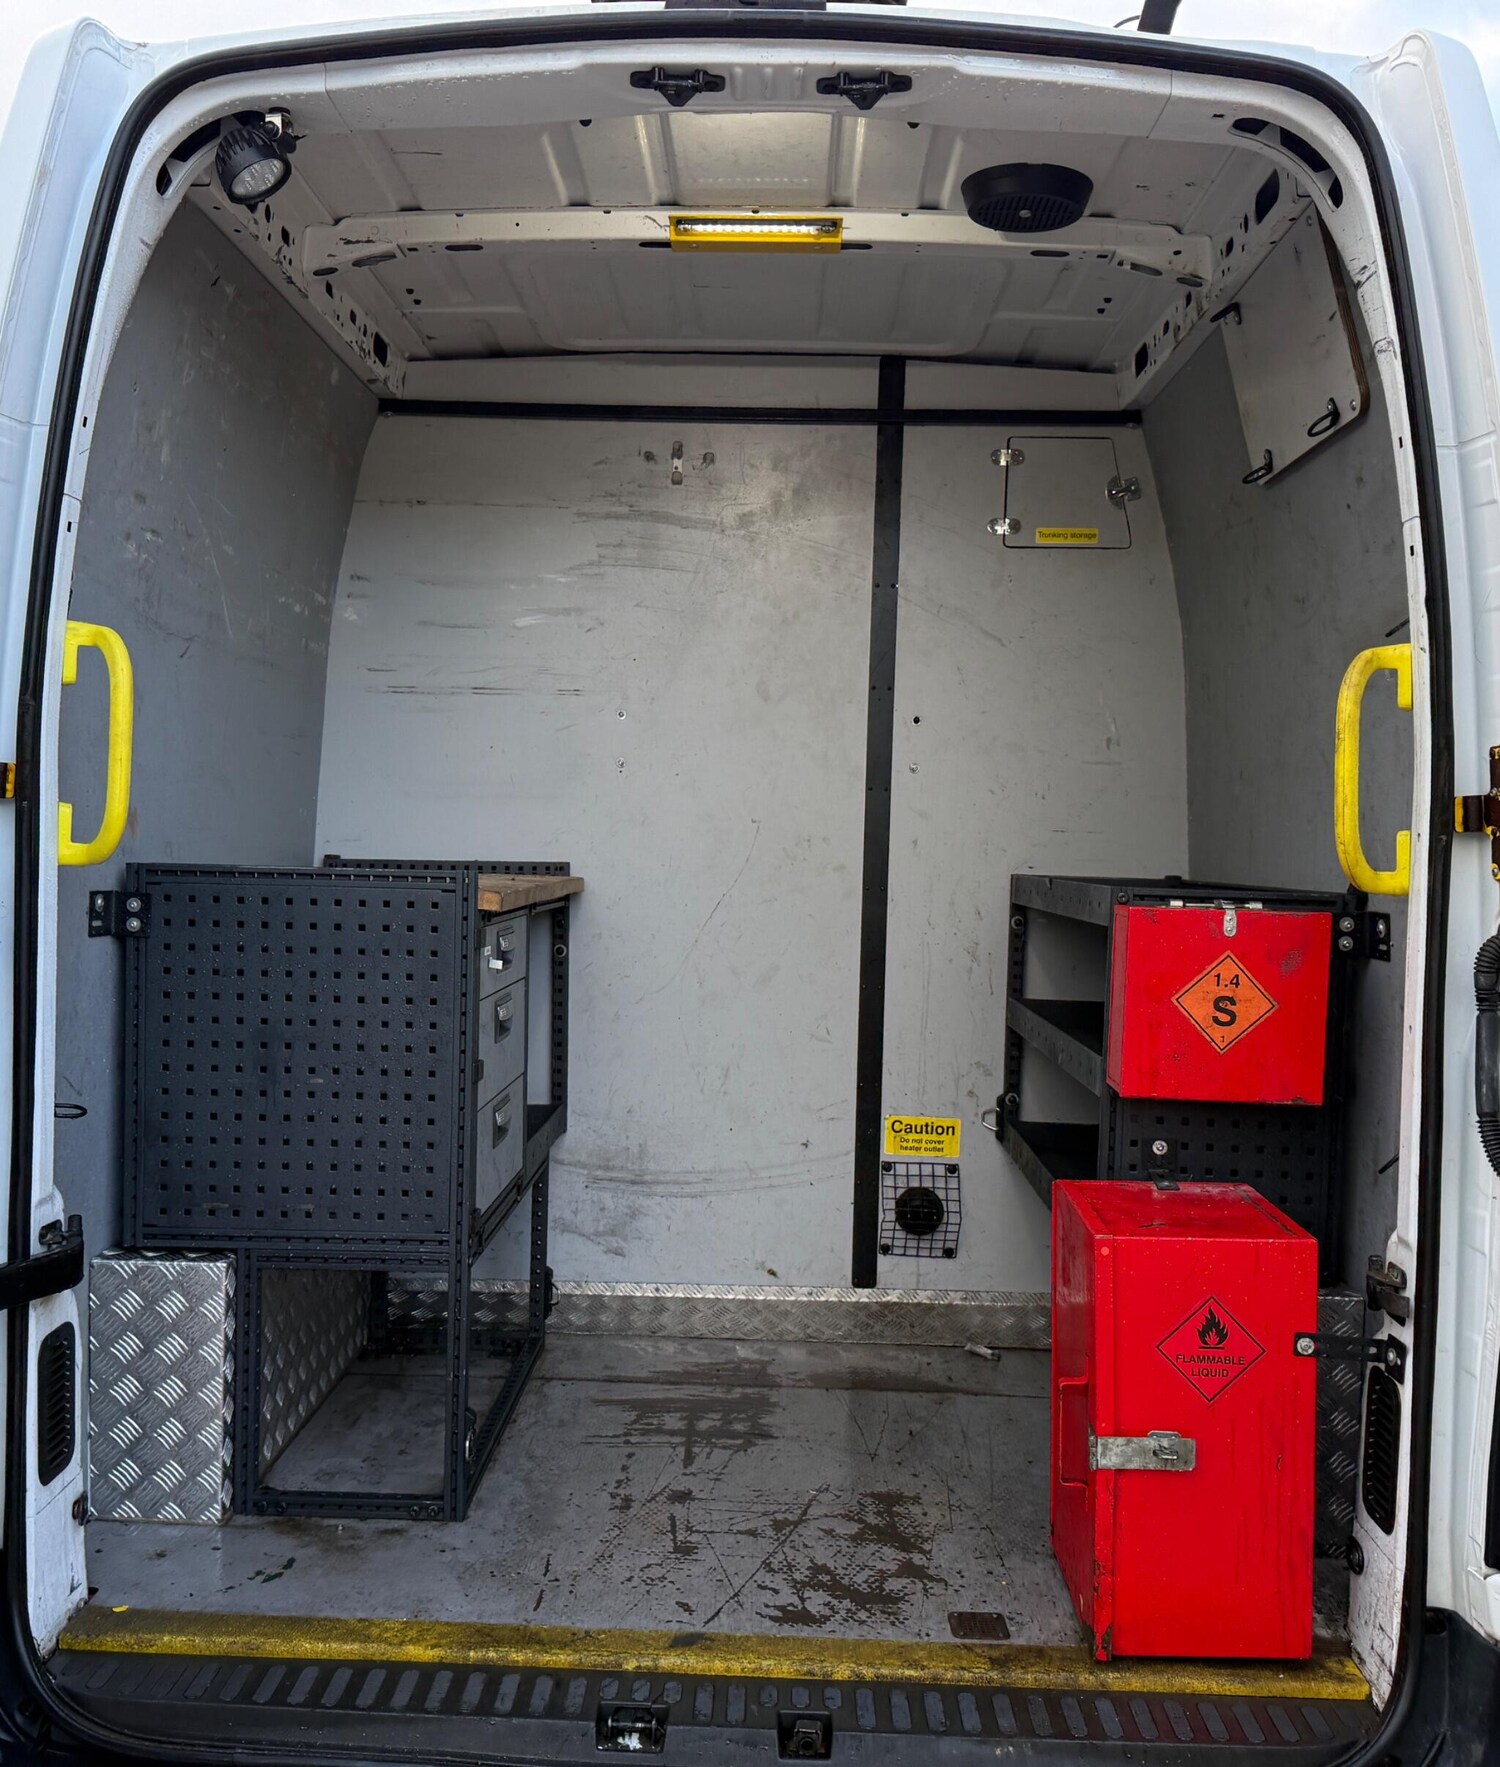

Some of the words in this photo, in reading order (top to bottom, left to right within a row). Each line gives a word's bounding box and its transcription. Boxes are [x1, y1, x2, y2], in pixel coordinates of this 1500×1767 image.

[1038, 531, 1068, 540] Trunking
[1214, 972, 1241, 989] 1.4
[1211, 995, 1237, 1027] S
[1220, 1035, 1225, 1043] 1
[891, 1119, 956, 1136] Caution
[899, 1136, 911, 1144] Do
[924, 1138, 945, 1146] cover
[899, 1144, 922, 1152] heater
[923, 1145, 944, 1153] outlet
[1175, 1354, 1246, 1366] FLAMMABLE
[1190, 1368, 1230, 1378] LIQUID
